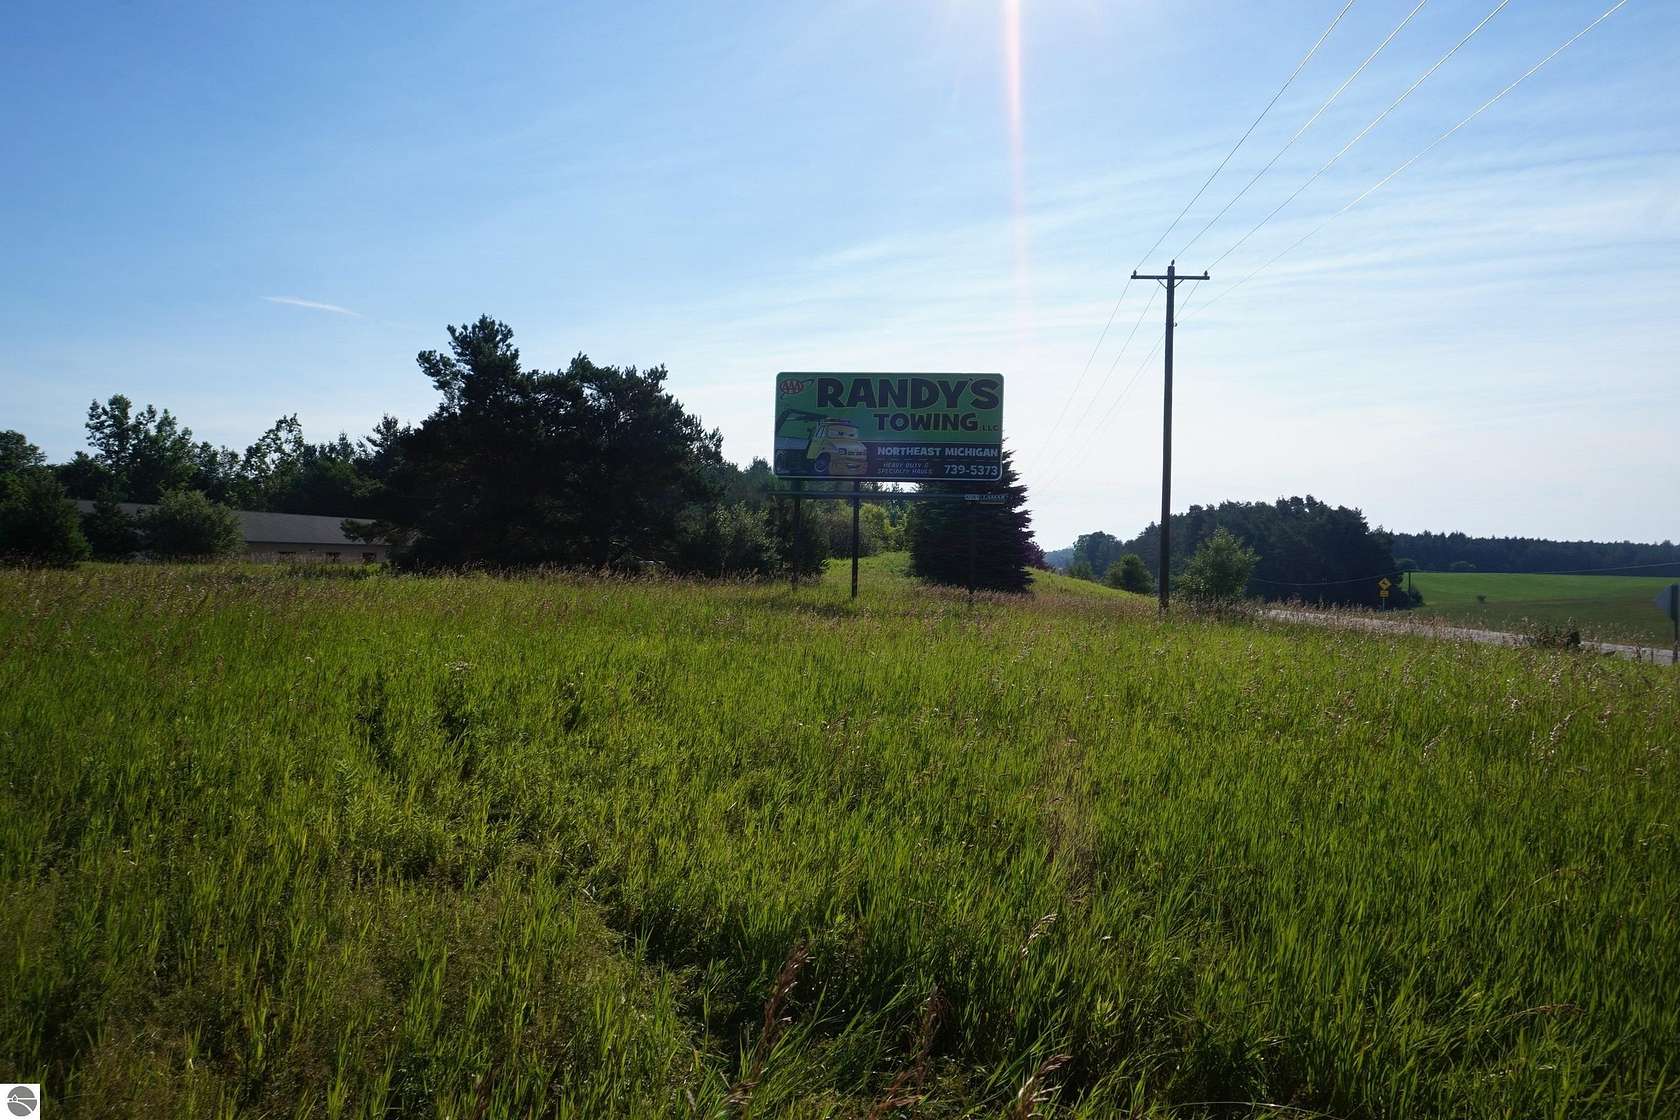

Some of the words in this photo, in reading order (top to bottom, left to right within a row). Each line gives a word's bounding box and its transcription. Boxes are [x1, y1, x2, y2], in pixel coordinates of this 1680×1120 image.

[816, 377, 1000, 410] RANDY'S
[874, 413, 978, 432] TOWING
[877, 447, 941, 456] NORTHEAST
[945, 447, 998, 457] MICHIGAN
[944, 464, 998, 476] 739-5373
